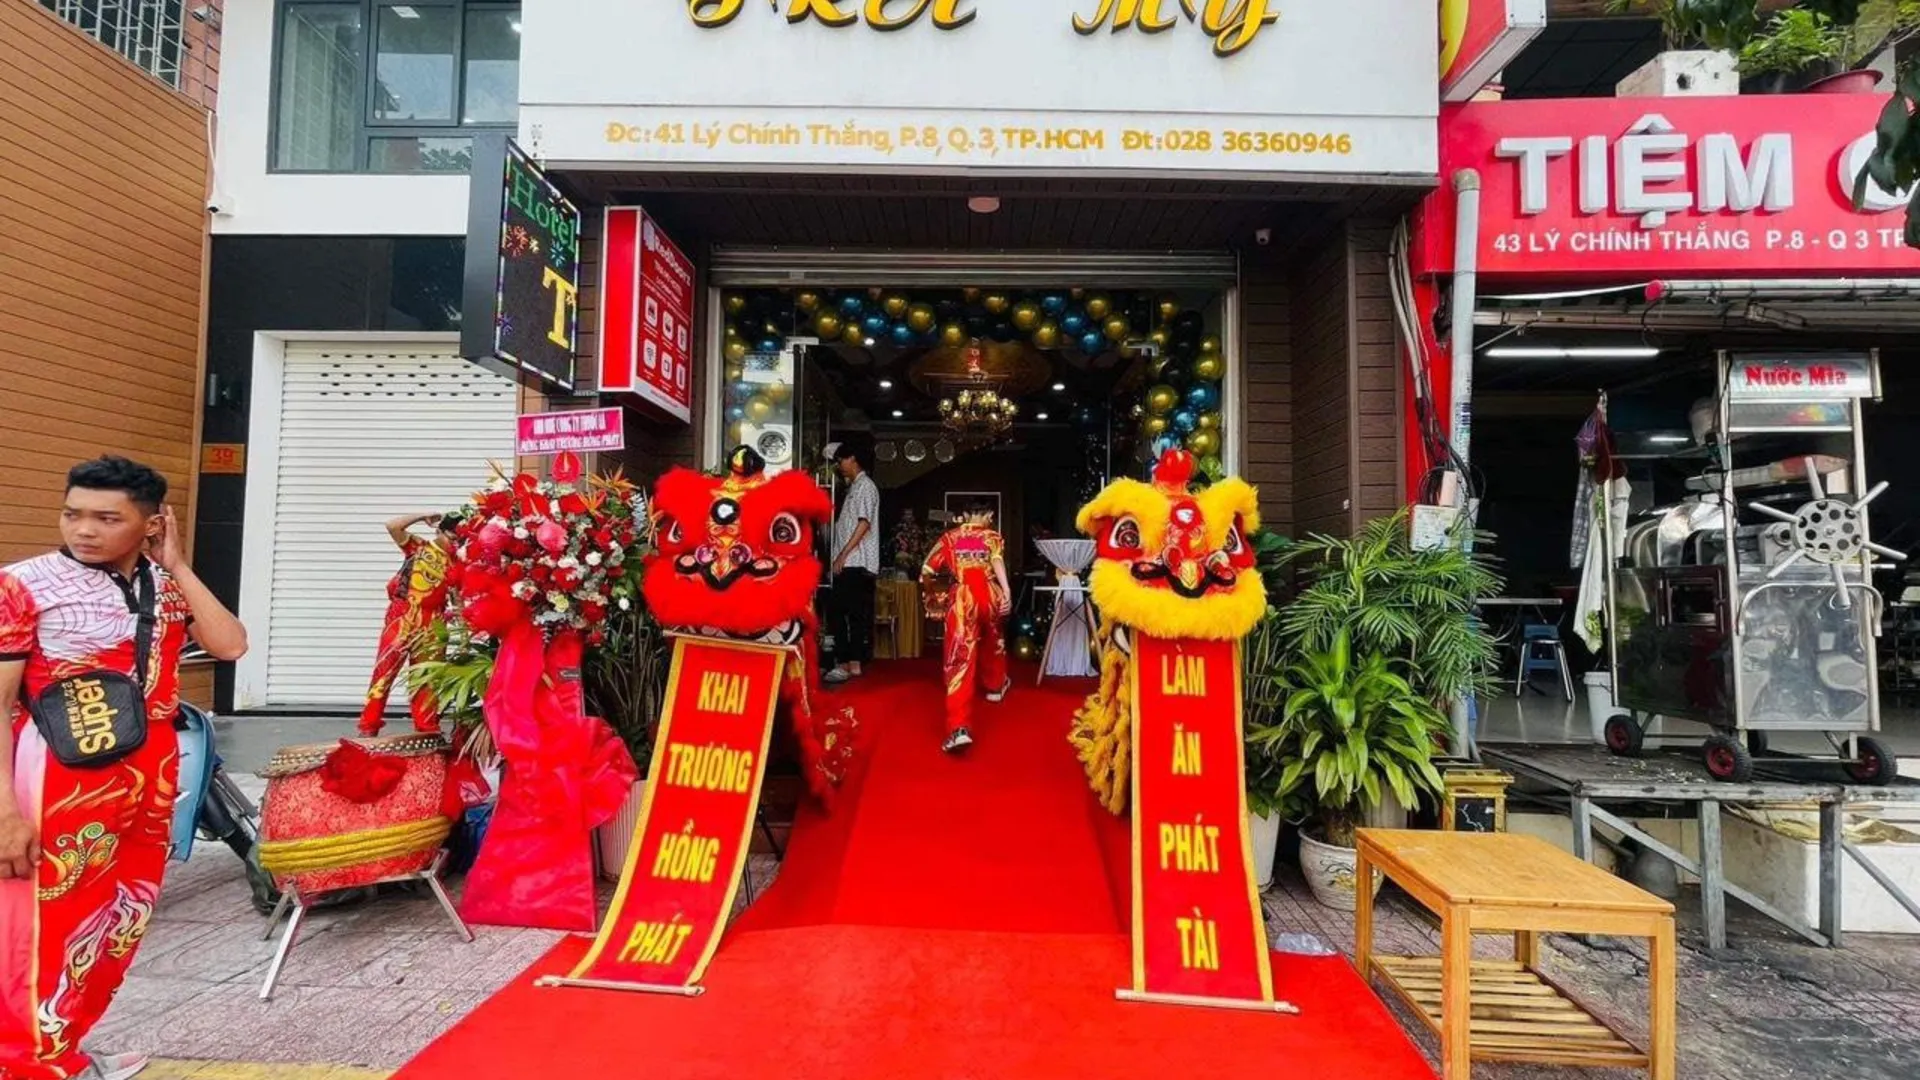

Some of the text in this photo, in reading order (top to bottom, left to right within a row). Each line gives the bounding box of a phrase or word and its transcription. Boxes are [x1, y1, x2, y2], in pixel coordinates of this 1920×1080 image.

[691, 122, 721, 149] Lý
[727, 122, 801, 146] Chính
[1002, 127, 1105, 151] TP.HCM
[1221, 130, 1352, 155] 36360946
[1495, 113, 1795, 228] TIỆM
[510, 165, 576, 254] Hotel
[1494, 233, 1521, 252] 43
[1529, 228, 1561, 252] LÝ
[1569, 228, 1651, 252] CHÍNH
[1659, 220, 1750, 250] THẮNG
[1765, 230, 1805, 250] P.8
[1827, 229, 1848, 250] Q
[1854, 229, 1870, 250] 3
[542, 266, 577, 350] T
[697, 671, 749, 715] KHAI
[1162, 644, 1207, 697] LÀM
[73, 678, 118, 755] Super
[666, 741, 753, 793] TRƯƠNG
[1171, 722, 1202, 776] ĂN
[652, 819, 720, 883] HỒNG
[1159, 813, 1220, 873] PHÁT
[617, 912, 693, 965] PHÁT
[1176, 907, 1220, 971] TÀI
